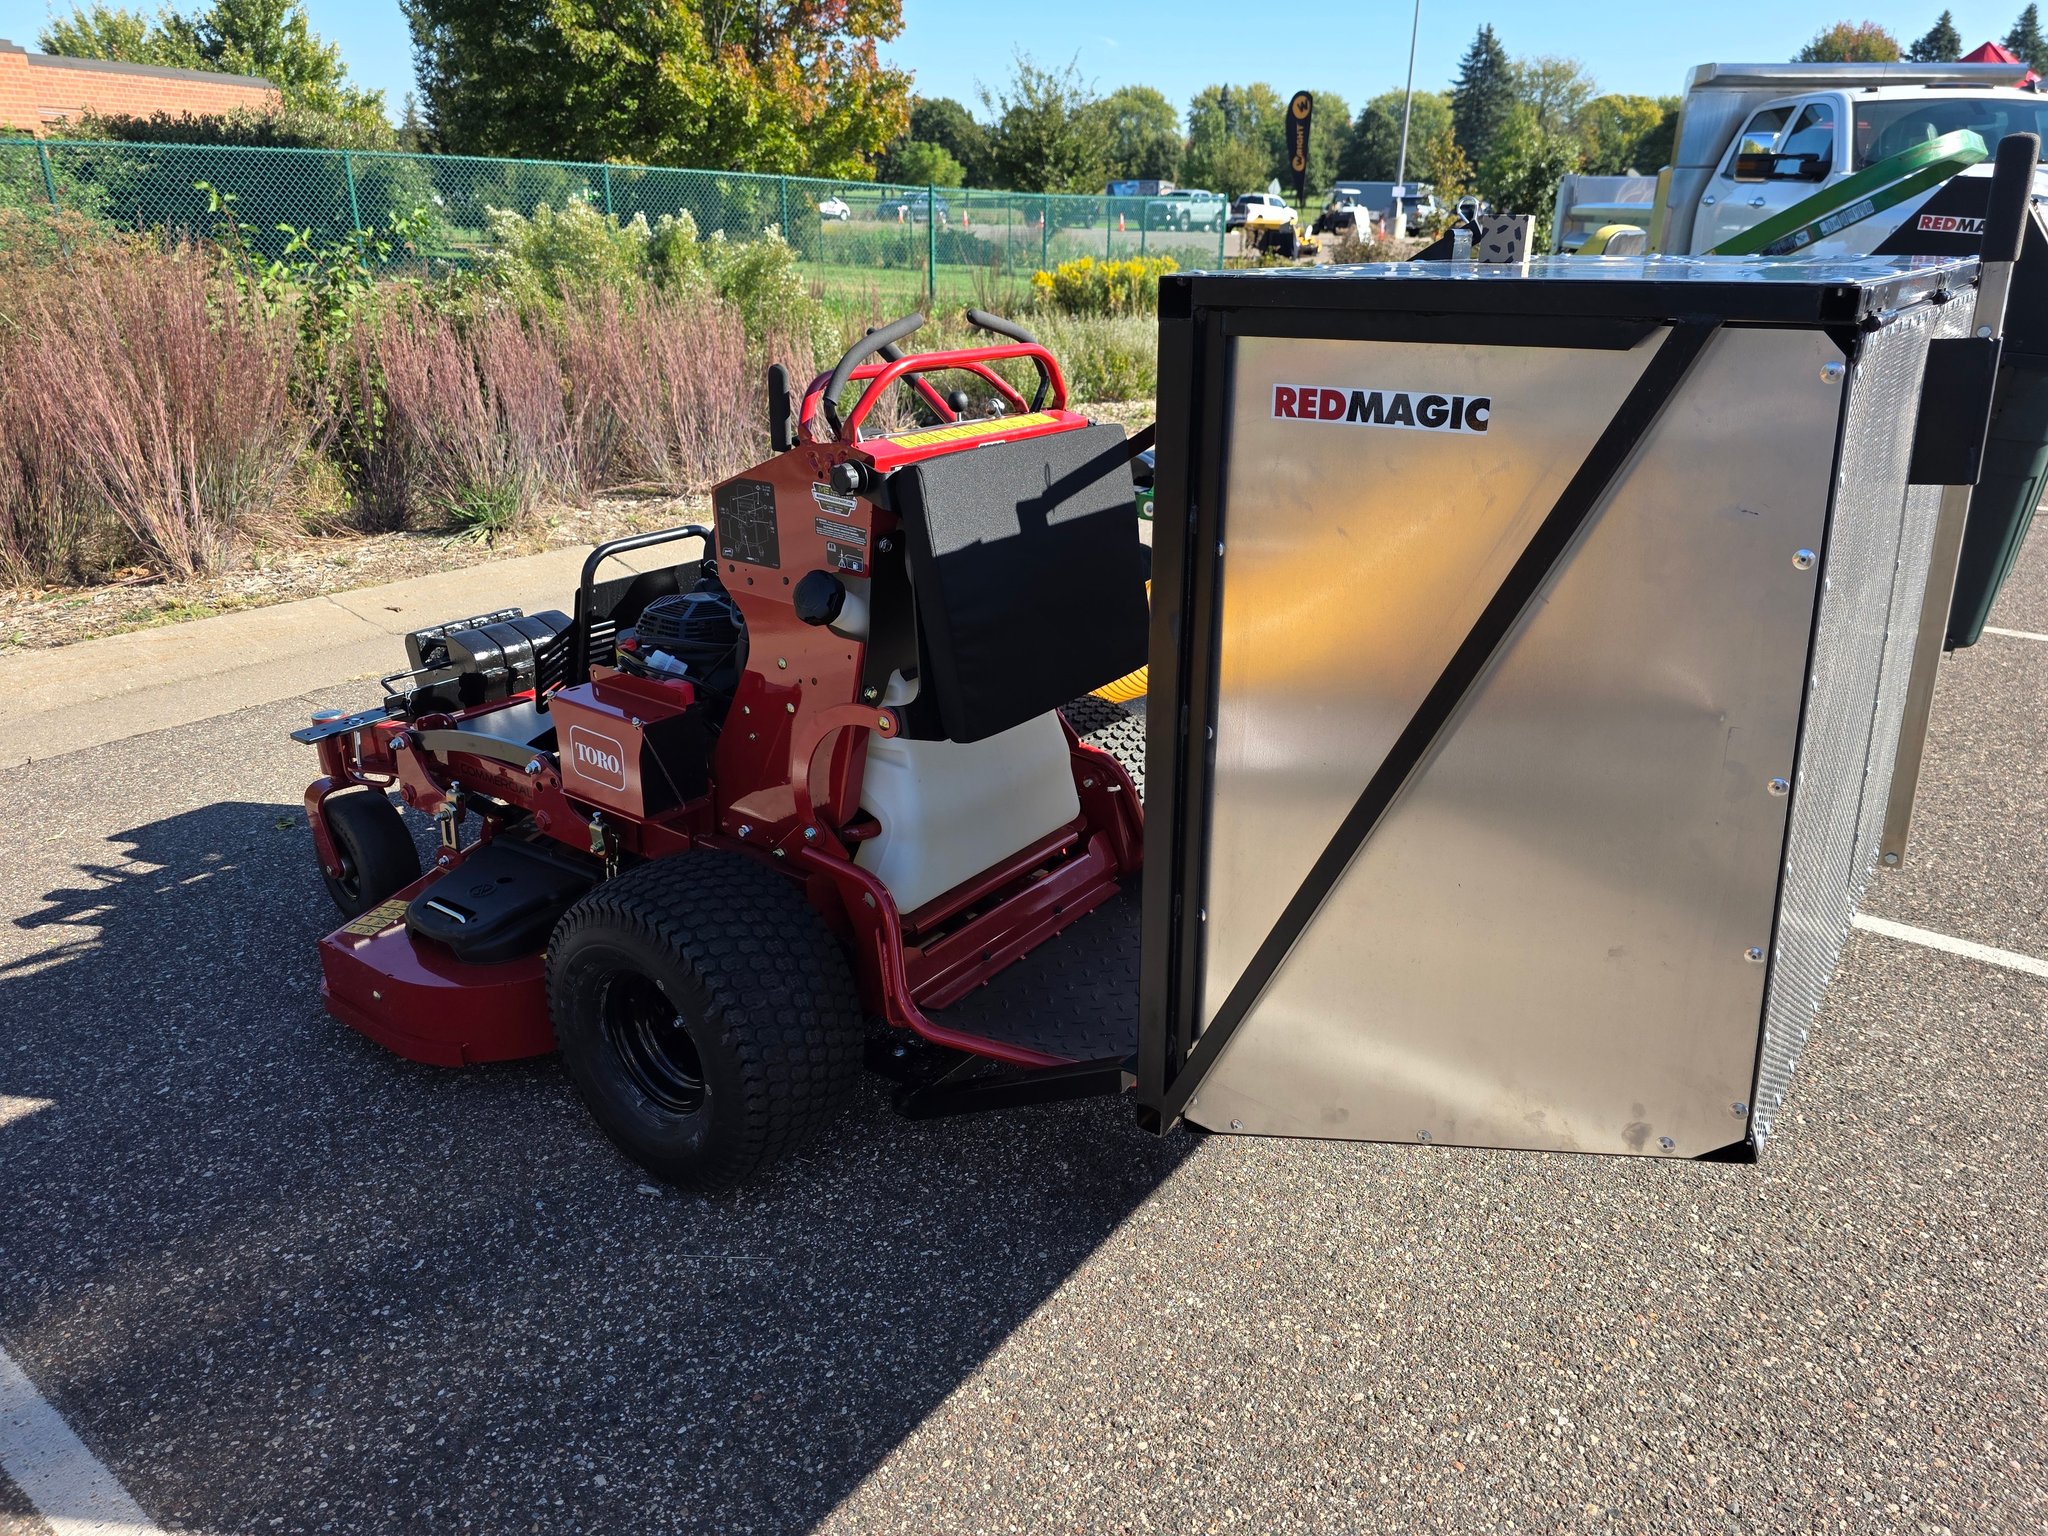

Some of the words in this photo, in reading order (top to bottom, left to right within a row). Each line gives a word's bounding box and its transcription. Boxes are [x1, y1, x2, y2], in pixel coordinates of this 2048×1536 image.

[1294, 124, 1304, 168] WRIGHT
[1919, 215, 1986, 232] REDMA
[1274, 386, 1491, 432] REDMAGIC
[575, 742, 620, 773] TORO
[461, 764, 532, 797] COMMERCIAL
